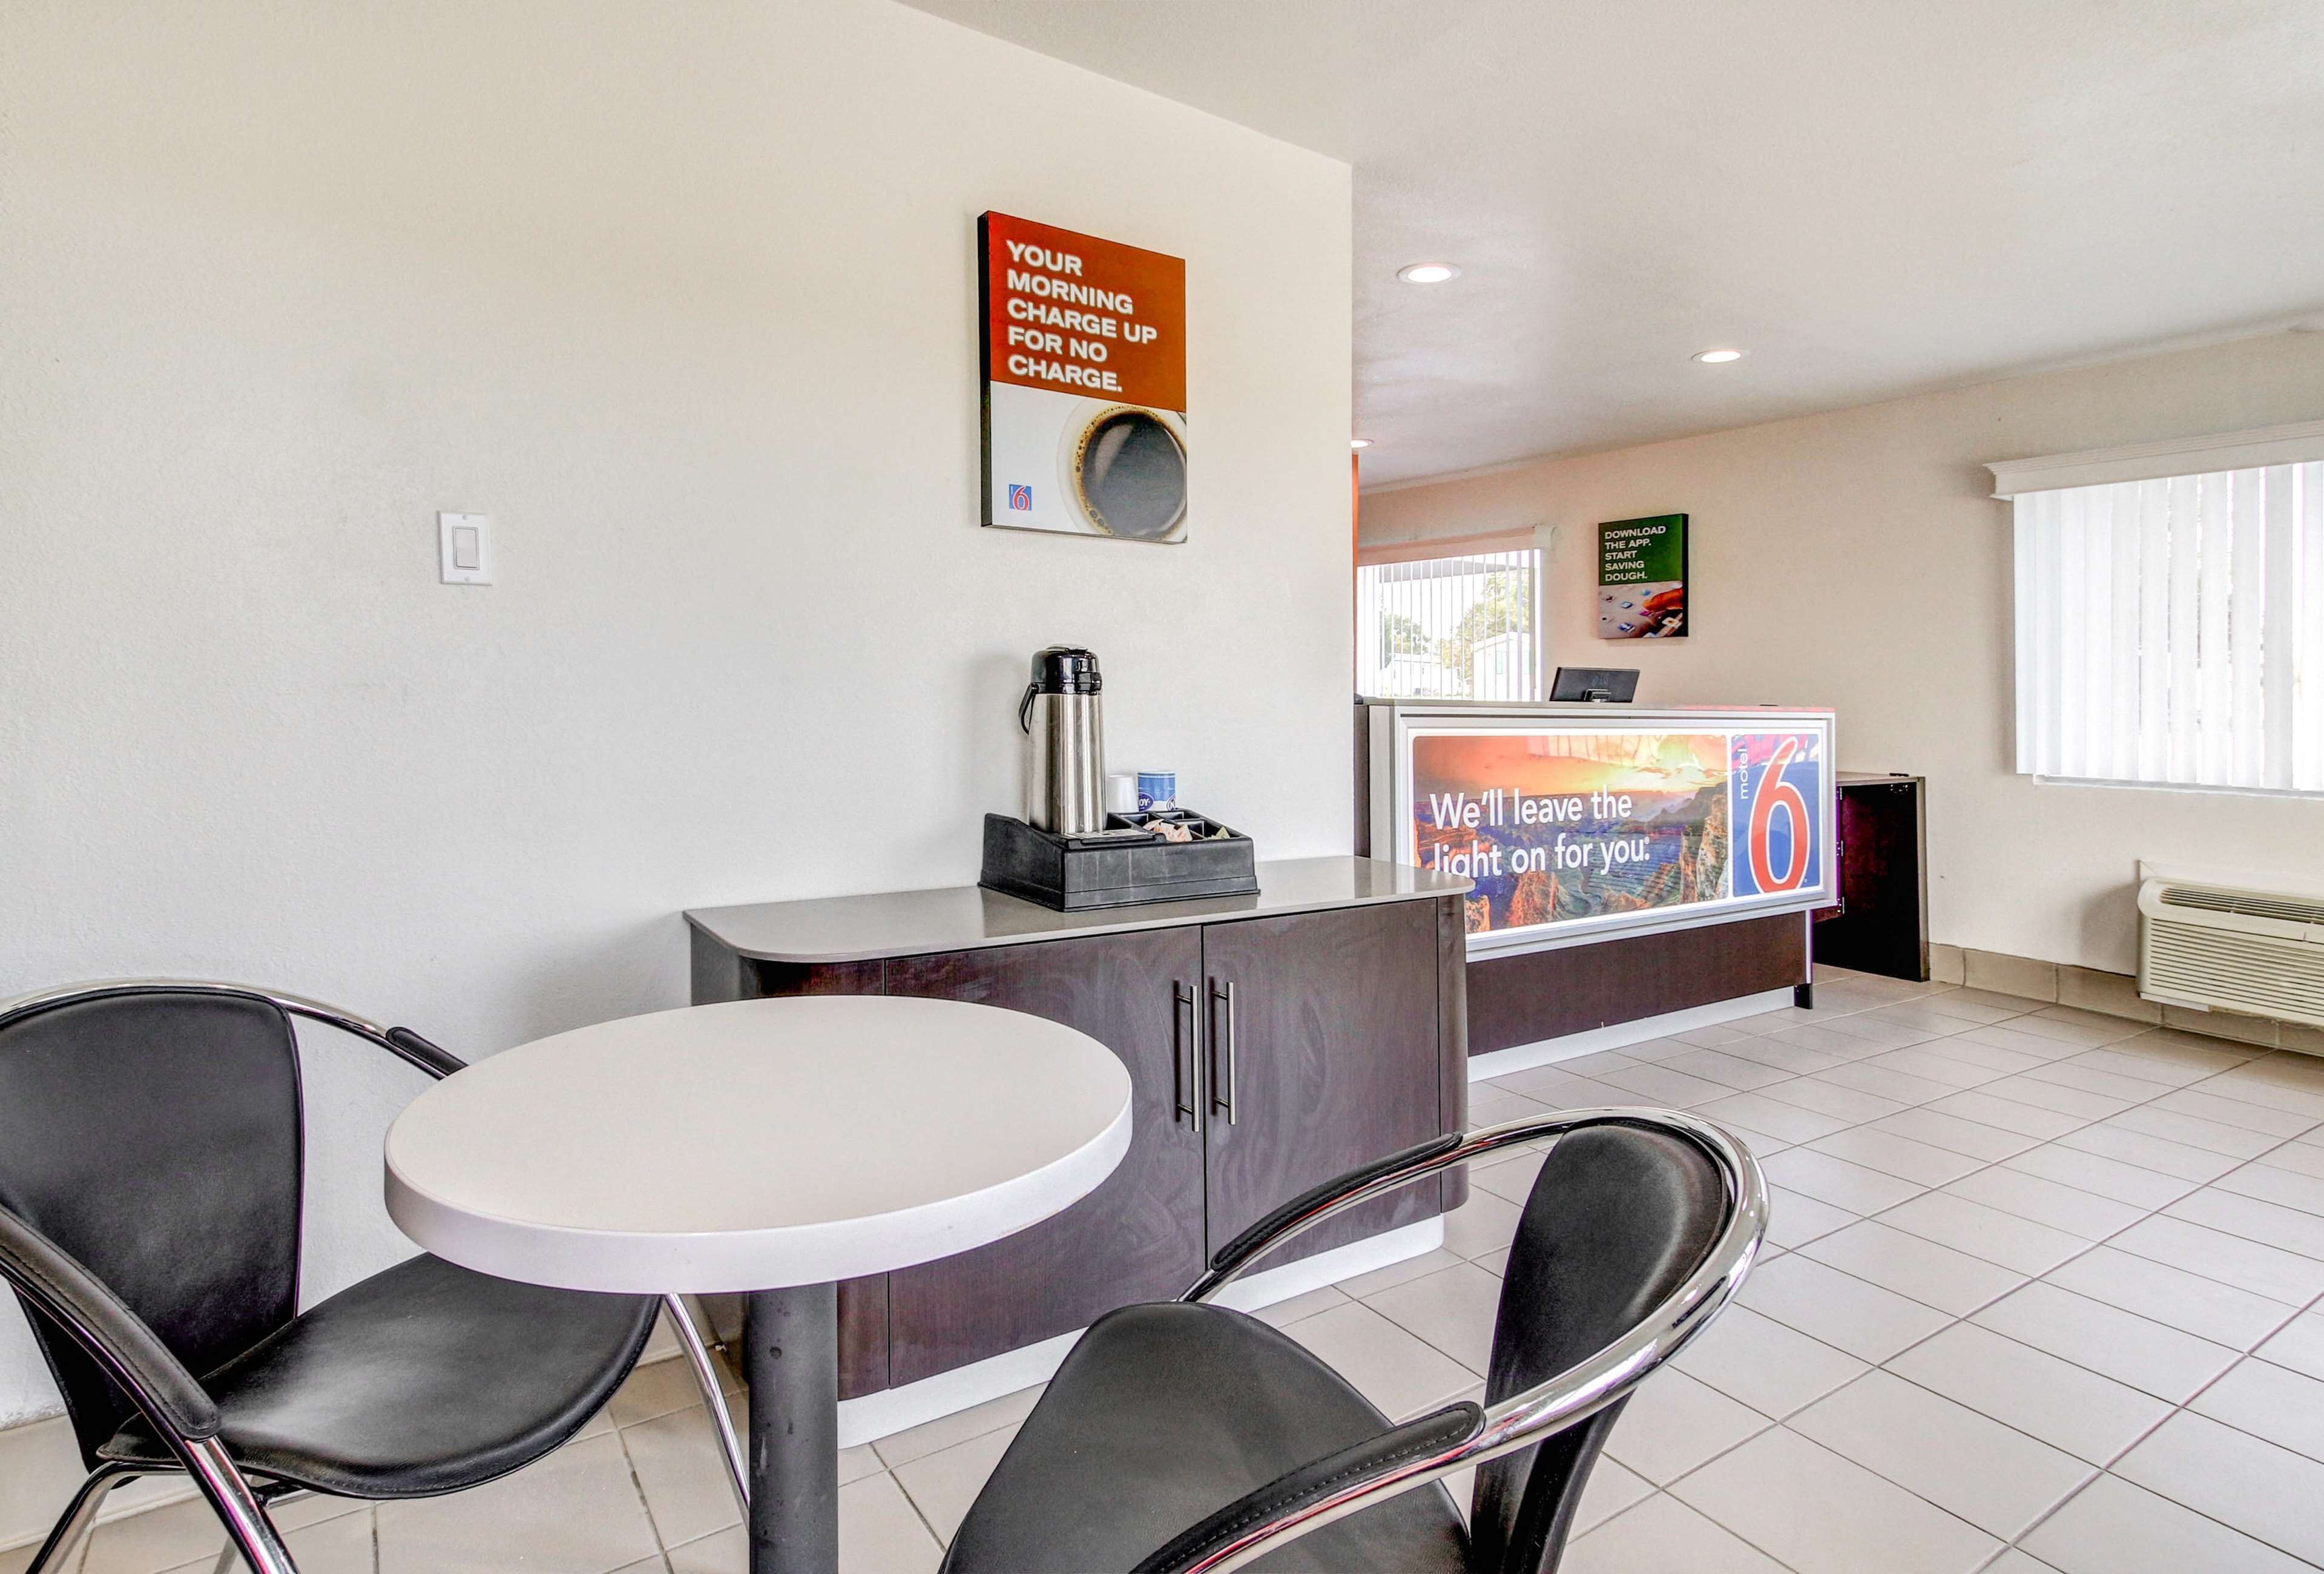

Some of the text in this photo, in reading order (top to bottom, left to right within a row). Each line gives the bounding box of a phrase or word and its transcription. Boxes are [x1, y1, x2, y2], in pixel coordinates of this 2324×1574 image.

[1006, 239, 1082, 277] YOUR
[1007, 268, 1133, 315] MORNING
[1007, 297, 1157, 344] CHARGE UP
[1008, 325, 1107, 363] FOR NO
[1008, 354, 1123, 392] CHARGE.
[1012, 486, 1030, 511] 6
[1604, 525, 1666, 539] DOWNLOAD
[1605, 538, 1651, 550] THE APP.
[1605, 550, 1637, 561] START
[1605, 561, 1645, 571] SAVING
[1605, 571, 1647, 581] DOUGH.
[1737, 748, 1748, 800] motel
[1429, 784, 1633, 830] We'll leave the
[1748, 736, 1811, 894] 6
[1511, 846, 1545, 874] on
[1555, 832, 1593, 869] for
